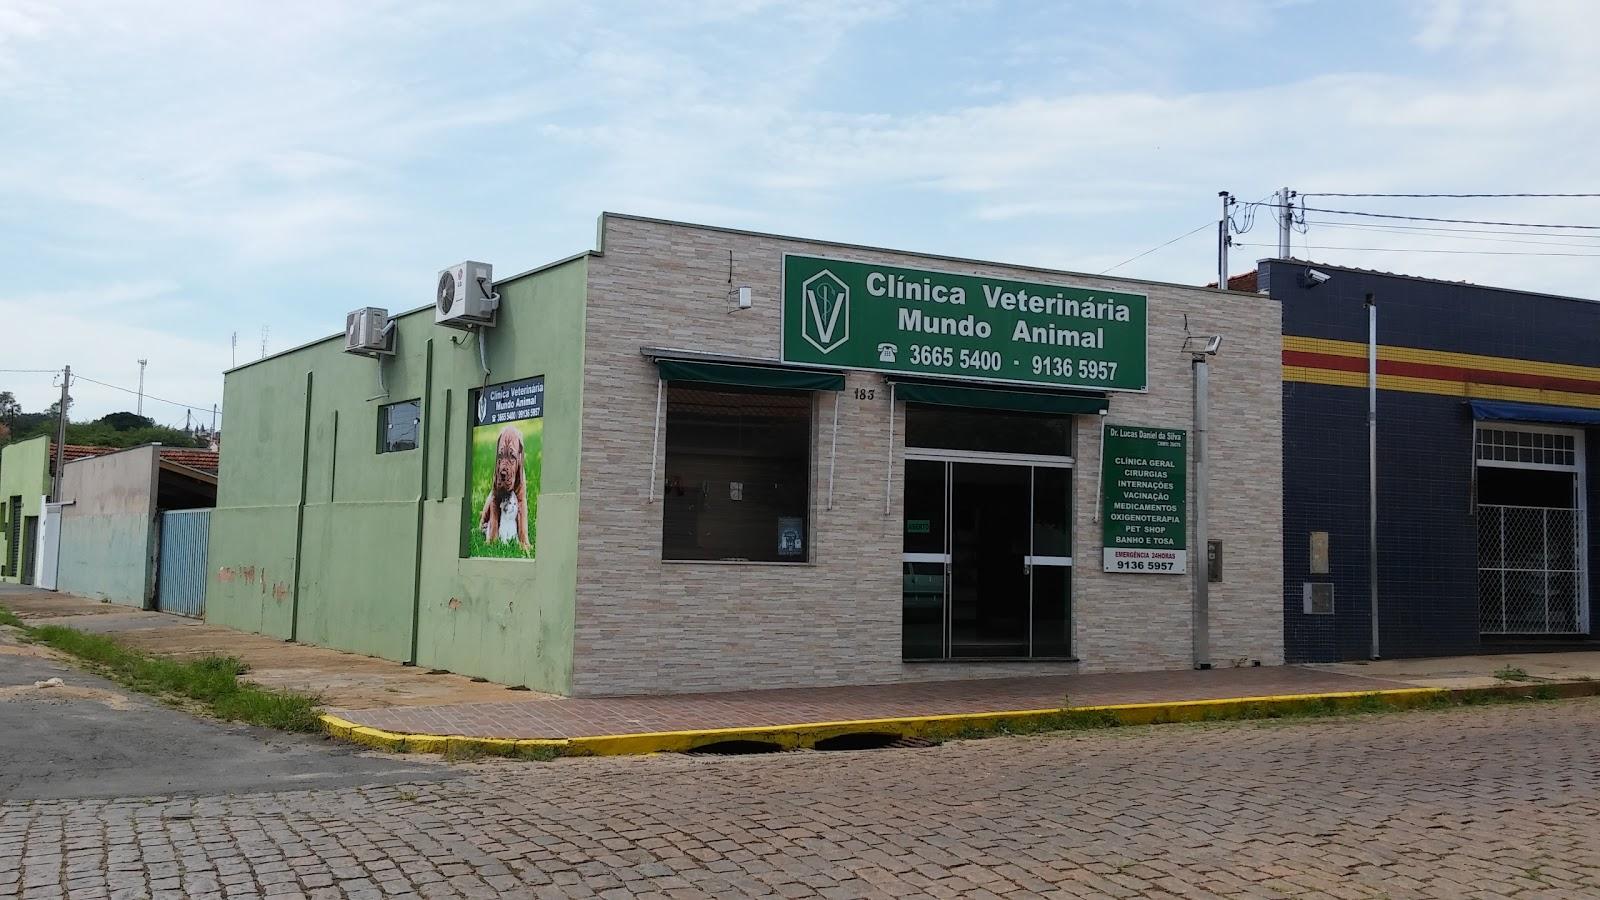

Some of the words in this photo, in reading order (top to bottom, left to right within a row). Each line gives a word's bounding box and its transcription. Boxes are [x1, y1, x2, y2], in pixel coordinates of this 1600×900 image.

[866, 271, 966, 306] Clínica
[982, 284, 1131, 322] Veterinária
[897, 306, 992, 339] Mundo
[1011, 319, 1105, 349] Animal
[909, 344, 954, 368] 3665
[959, 348, 1003, 372] 5400
[1031, 354, 1073, 378] 9136
[1077, 358, 1118, 381] 5957
[490, 389, 510, 401] Clínica
[511, 382, 544, 397] Veterinária
[854, 387, 875, 401] 183
[495, 400, 515, 411] Mundo
[515, 394, 537, 408] Animal
[1110, 427, 1119, 438] Dr.
[1120, 428, 1138, 439] Lucas
[1138, 430, 1158, 440] Daniel
[1158, 431, 1166, 440] da
[1166, 431, 1182, 441] Silva
[1114, 456, 1148, 466] CLÍNICA
[1149, 459, 1176, 468] GERAL
[1124, 469, 1168, 479] CIRURGIAS
[1117, 480, 1174, 490] INTERNAÇÕES
[1123, 491, 1170, 501] VACINAÇÃO
[1113, 502, 1177, 512] MEDICAMENTOS
[1110, 513, 1180, 523] OXIGENOTERAPIA
[1125, 525, 1141, 533] PET
[1143, 526, 1166, 534] SHOP
[1115, 536, 1145, 544] BANHO
[1153, 537, 1175, 545] TOSA
[1115, 550, 1150, 559] EMERGÊNCIA
[1151, 552, 1176, 560] 24HORAS
[1117, 560, 1145, 570] 9136
[1147, 561, 1174, 571] 5957
